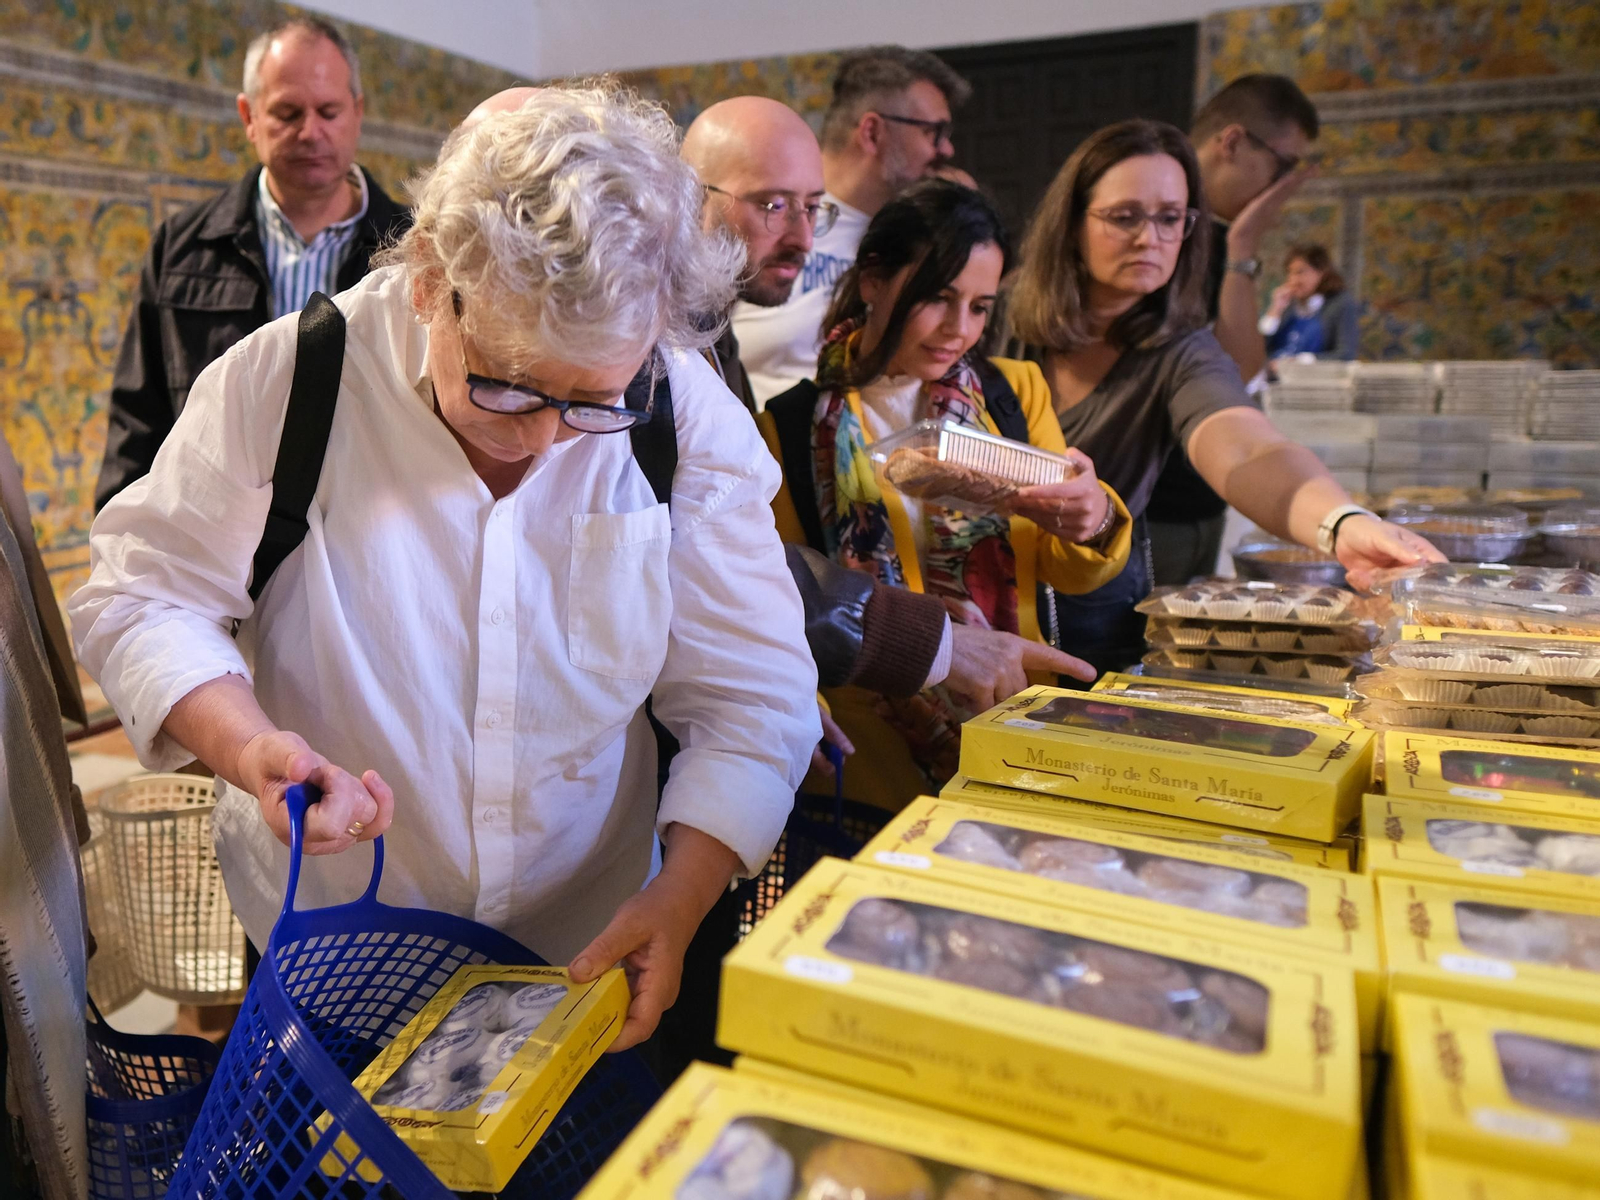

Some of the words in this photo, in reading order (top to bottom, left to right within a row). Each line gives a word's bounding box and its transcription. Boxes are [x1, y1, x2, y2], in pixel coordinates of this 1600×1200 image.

[1025, 747, 1117, 777] Monasterio
[1122, 766, 1141, 781] de
[1148, 767, 1199, 792] Santa
[1206, 776, 1264, 803] María
[1102, 777, 1176, 803] Jerónimas
